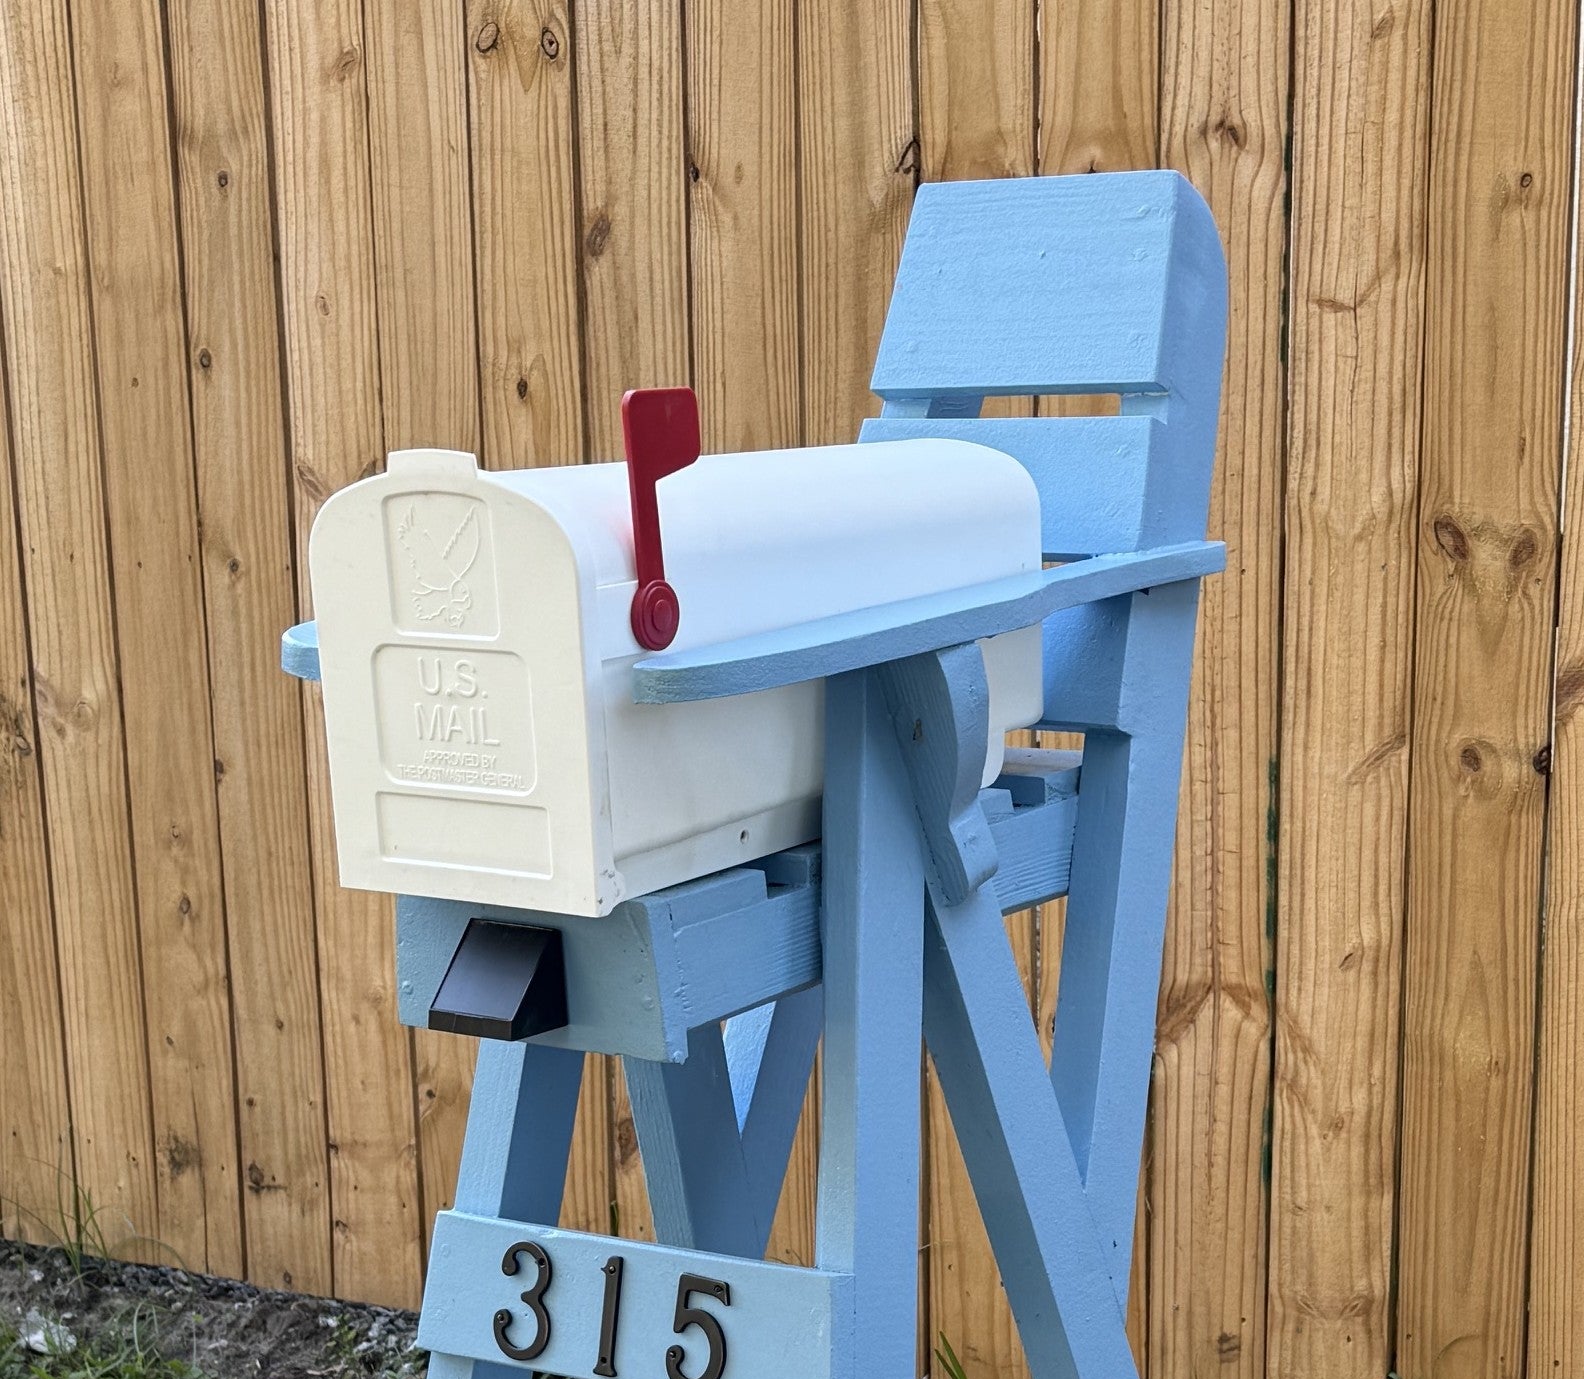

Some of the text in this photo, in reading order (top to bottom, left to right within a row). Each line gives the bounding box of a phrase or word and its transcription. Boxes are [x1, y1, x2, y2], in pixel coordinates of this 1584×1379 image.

[418, 657, 489, 698] U.S.
[413, 702, 501, 747] MAIL
[397, 763, 417, 778] THE
[423, 750, 497, 769] APPROVED BY
